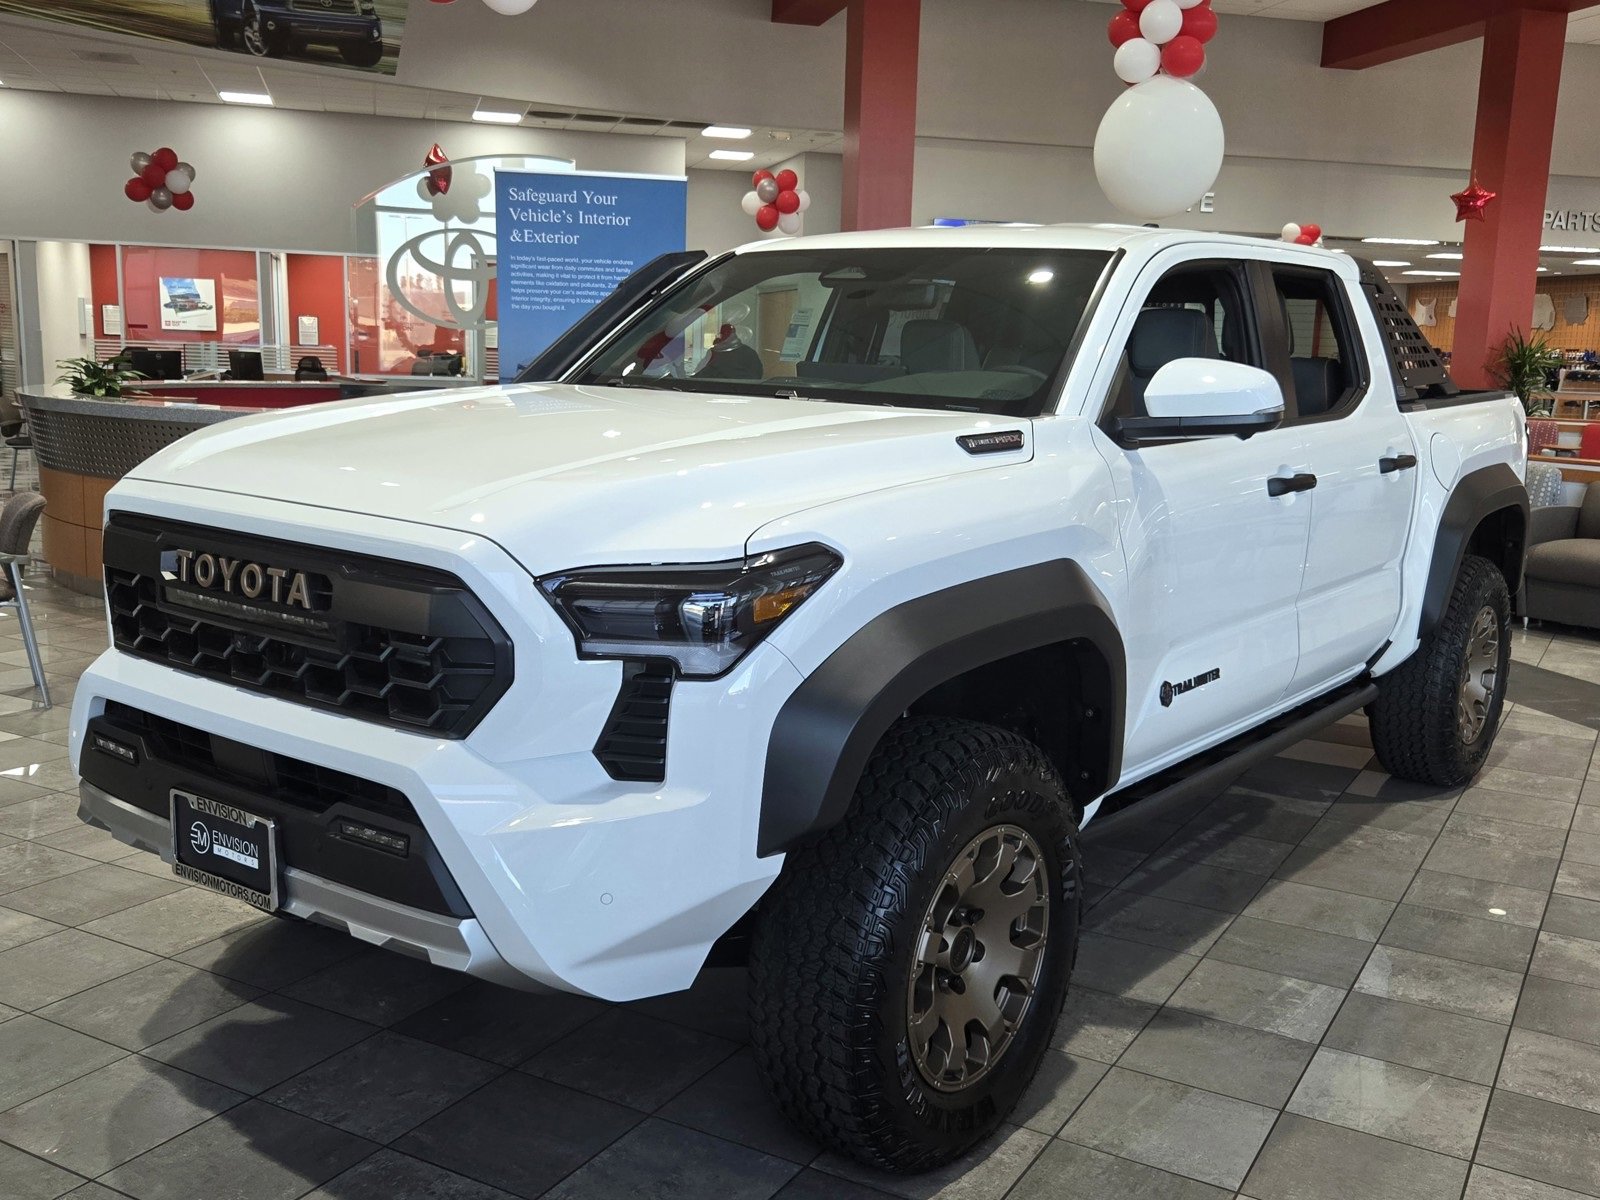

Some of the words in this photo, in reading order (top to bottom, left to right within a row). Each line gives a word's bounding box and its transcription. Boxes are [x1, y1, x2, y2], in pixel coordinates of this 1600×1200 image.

[508, 187, 578, 205] Safeguard
[582, 191, 618, 206] Your
[508, 208, 573, 224] Vehicle's
[578, 211, 632, 226] Interior
[1542, 210, 1600, 232] PARTS
[510, 230, 580, 245] &Exterior
[176, 548, 311, 609] TOYOTA
[196, 796, 247, 825] ENVISION
[212, 830, 258, 858] ENVISION
[217, 848, 255, 866] MOTORS
[176, 864, 270, 910] ENVISIONMOTORS.COM
